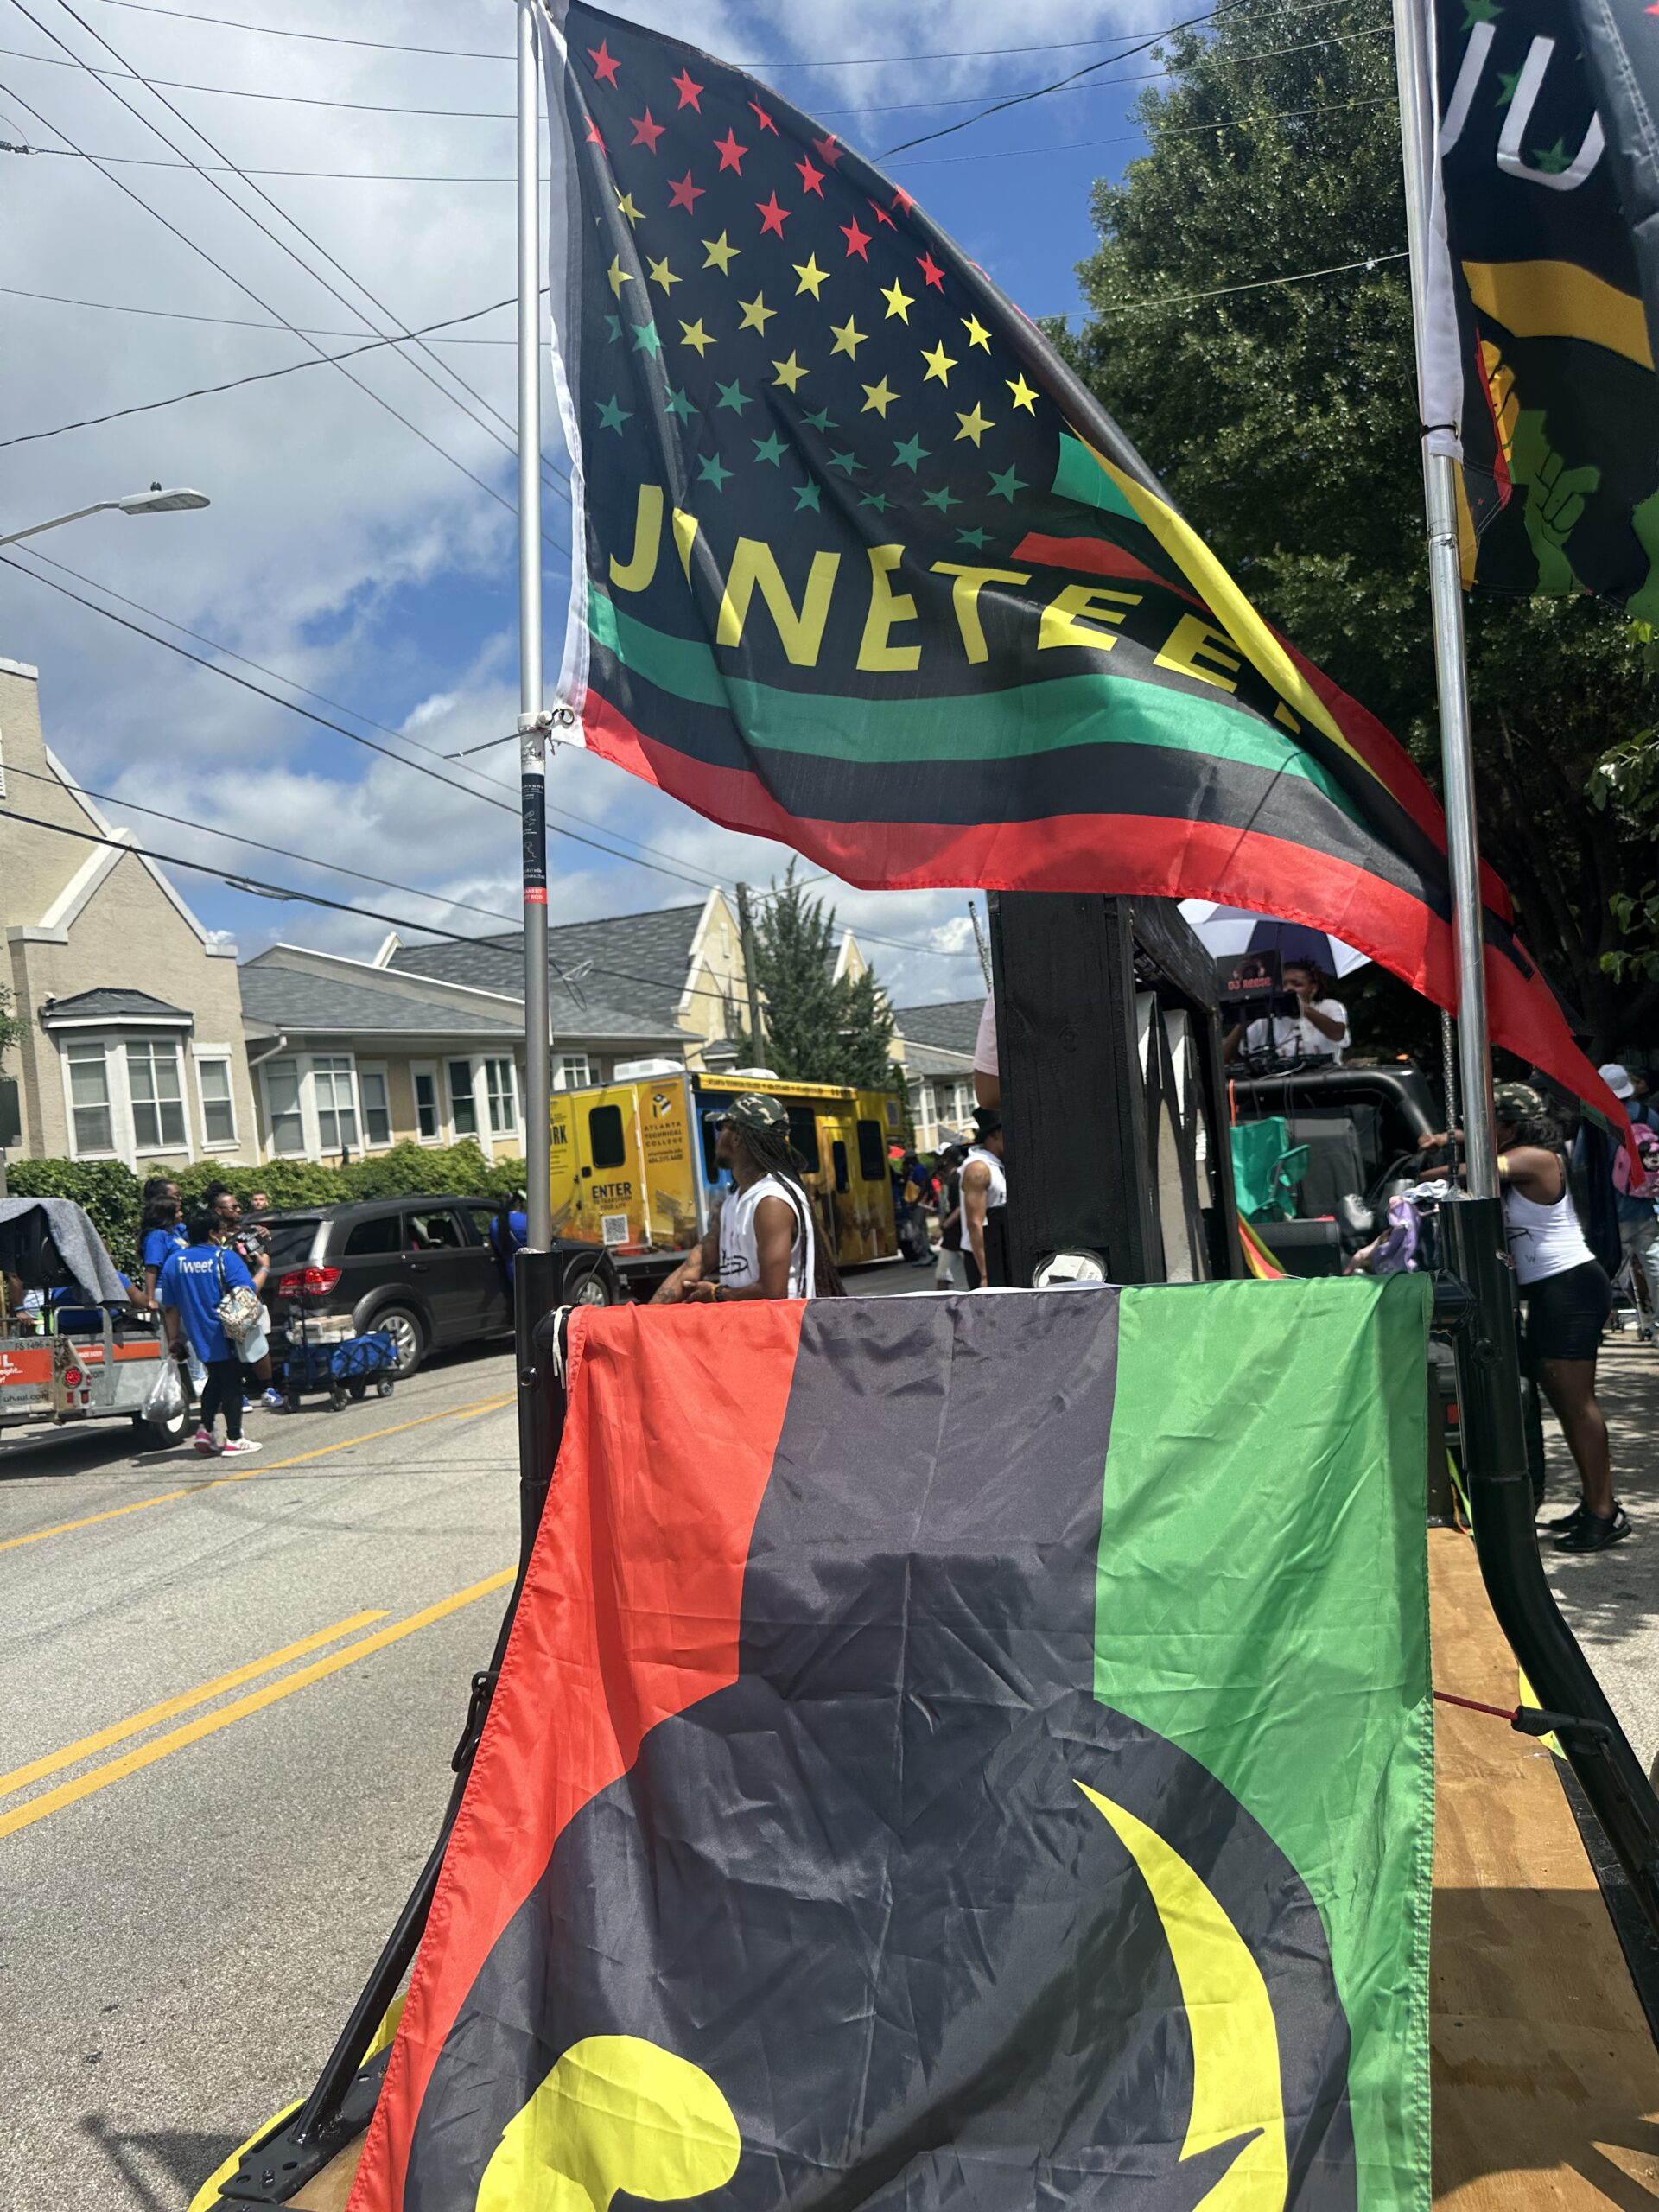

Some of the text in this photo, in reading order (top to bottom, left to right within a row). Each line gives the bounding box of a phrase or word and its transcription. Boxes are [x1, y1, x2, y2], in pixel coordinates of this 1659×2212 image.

[645, 1122, 681, 1132] ATLANTA
[645, 1129, 682, 1139] TECHNICAL
[645, 1137, 683, 1147] COLLEGE
[592, 1182, 632, 1198] ENTER
[177, 1256, 213, 1273] Tweet
